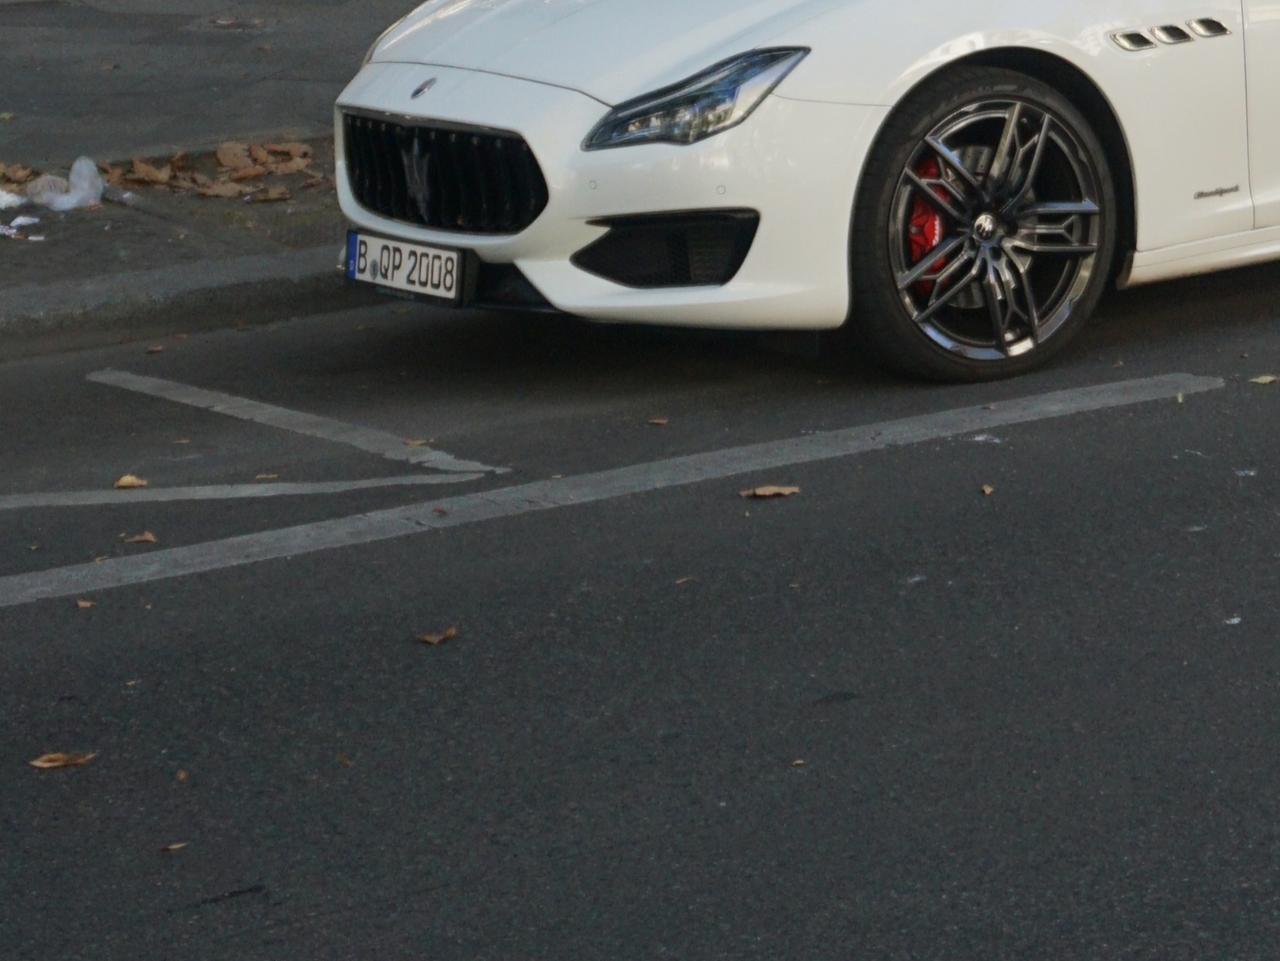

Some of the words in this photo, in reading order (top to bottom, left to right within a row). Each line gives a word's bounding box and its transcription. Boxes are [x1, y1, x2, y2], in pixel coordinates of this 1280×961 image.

[357, 239, 368, 275] B
[379, 244, 402, 282] QP
[406, 250, 455, 293] 2008
